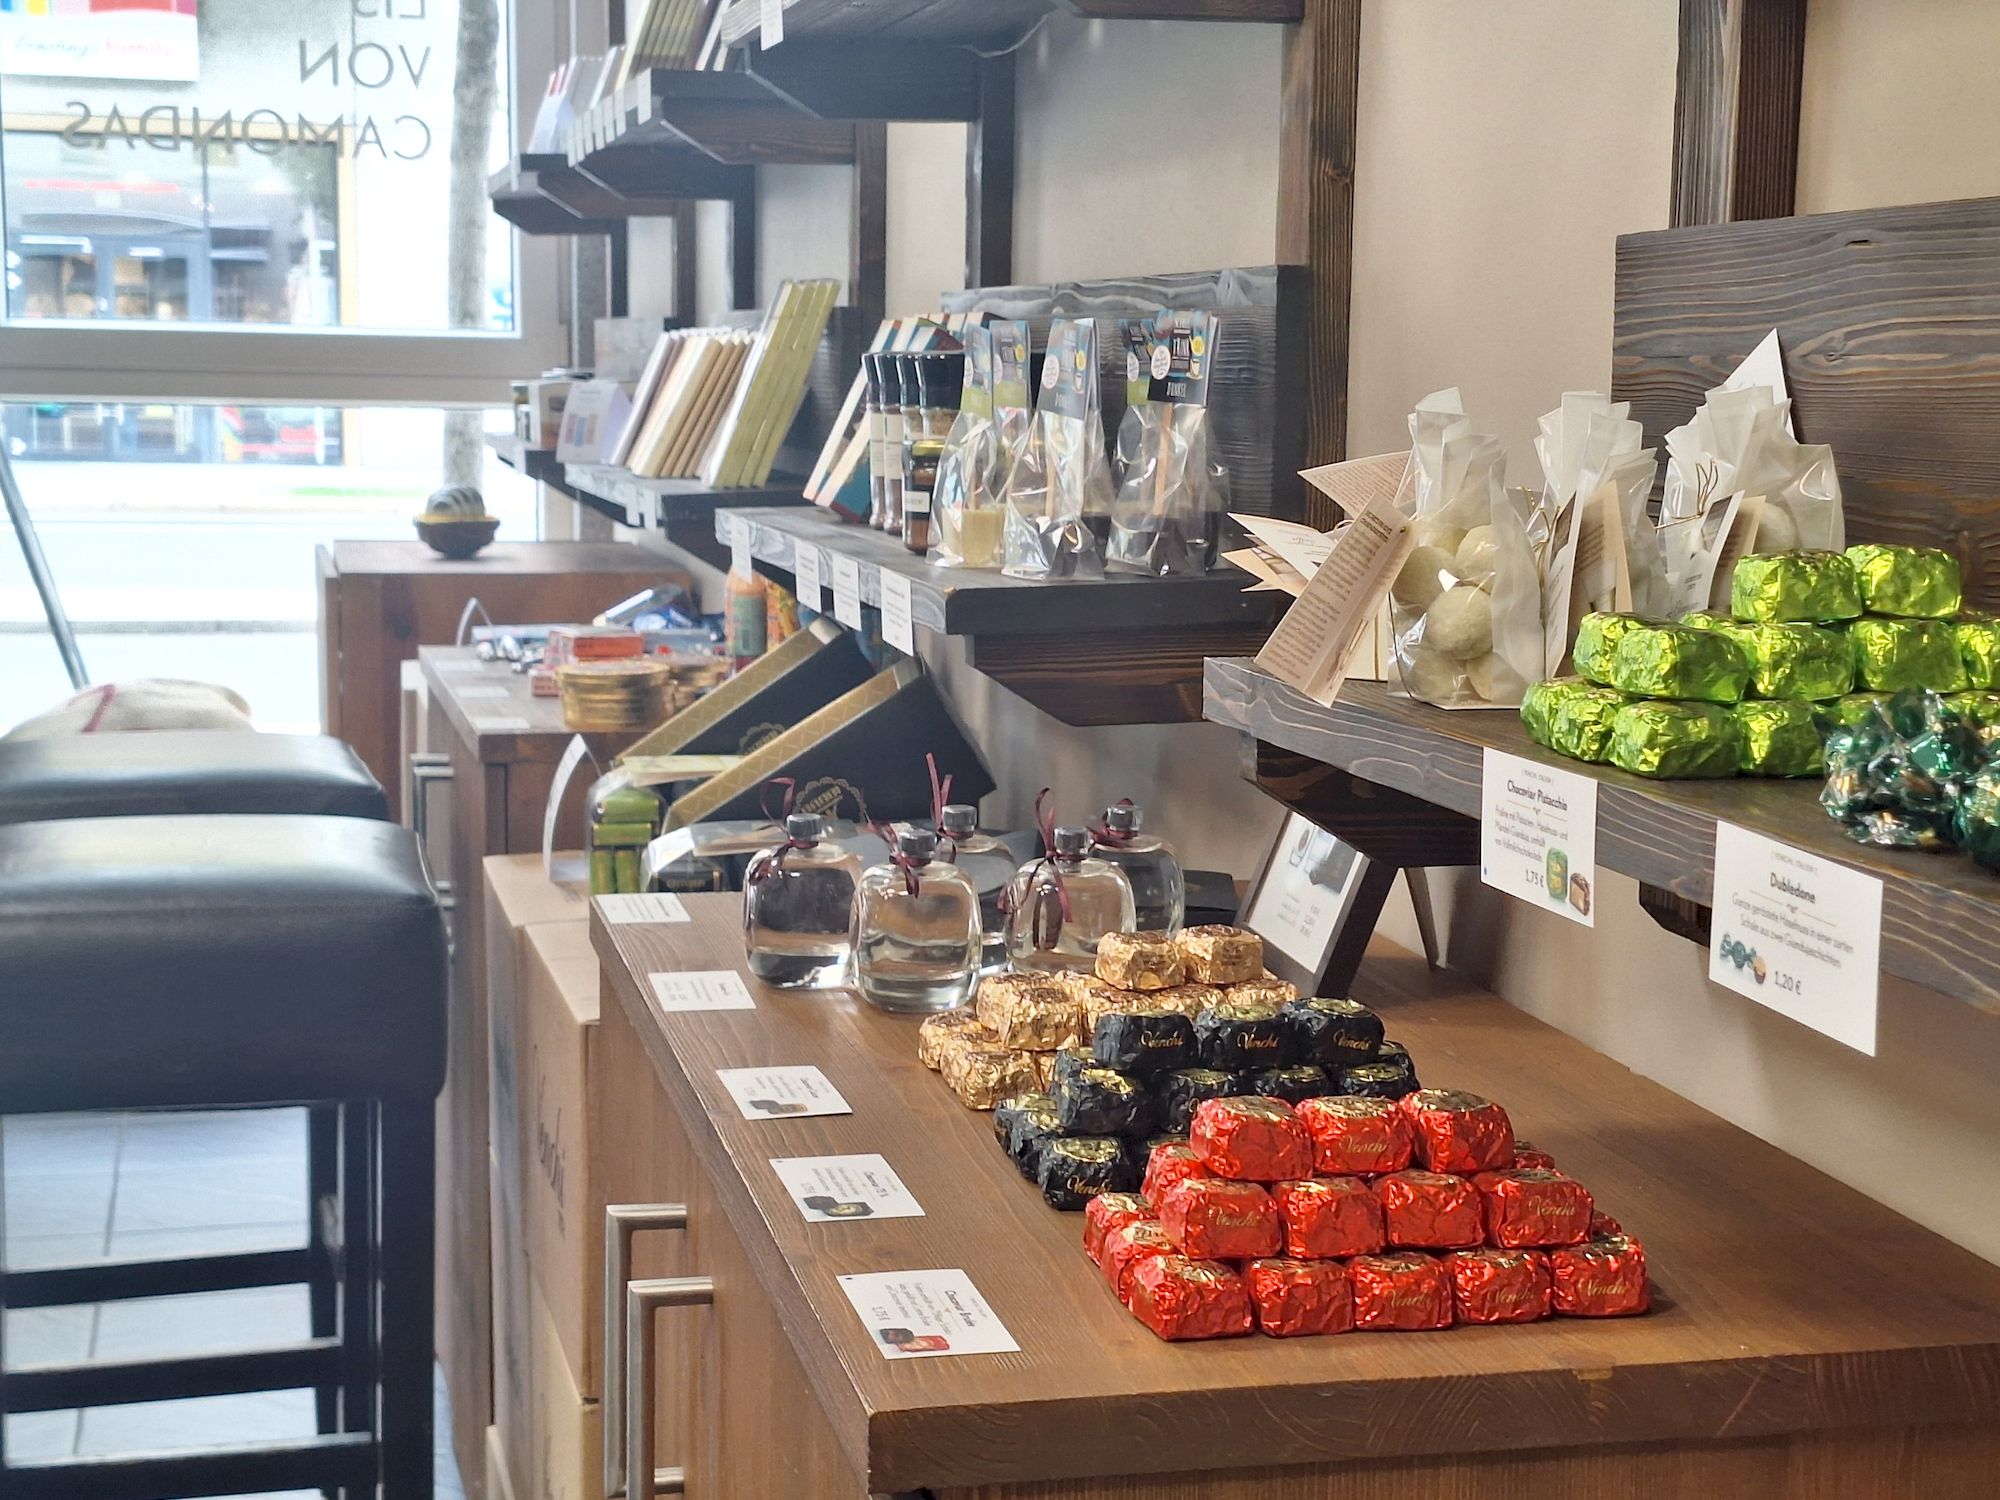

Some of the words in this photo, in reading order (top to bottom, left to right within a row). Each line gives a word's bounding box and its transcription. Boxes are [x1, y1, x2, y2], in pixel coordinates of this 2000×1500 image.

[1507, 779, 1535, 801] Chocaviar
[1537, 788, 1567, 811] Pistacchio
[1769, 871, 1816, 905] Dubledone
[1141, 1030, 1184, 1048] Venchi
[1237, 1027, 1279, 1050] Venchi
[1338, 1135, 1390, 1154] Venchi
[1529, 1195, 1577, 1216] Venchi
